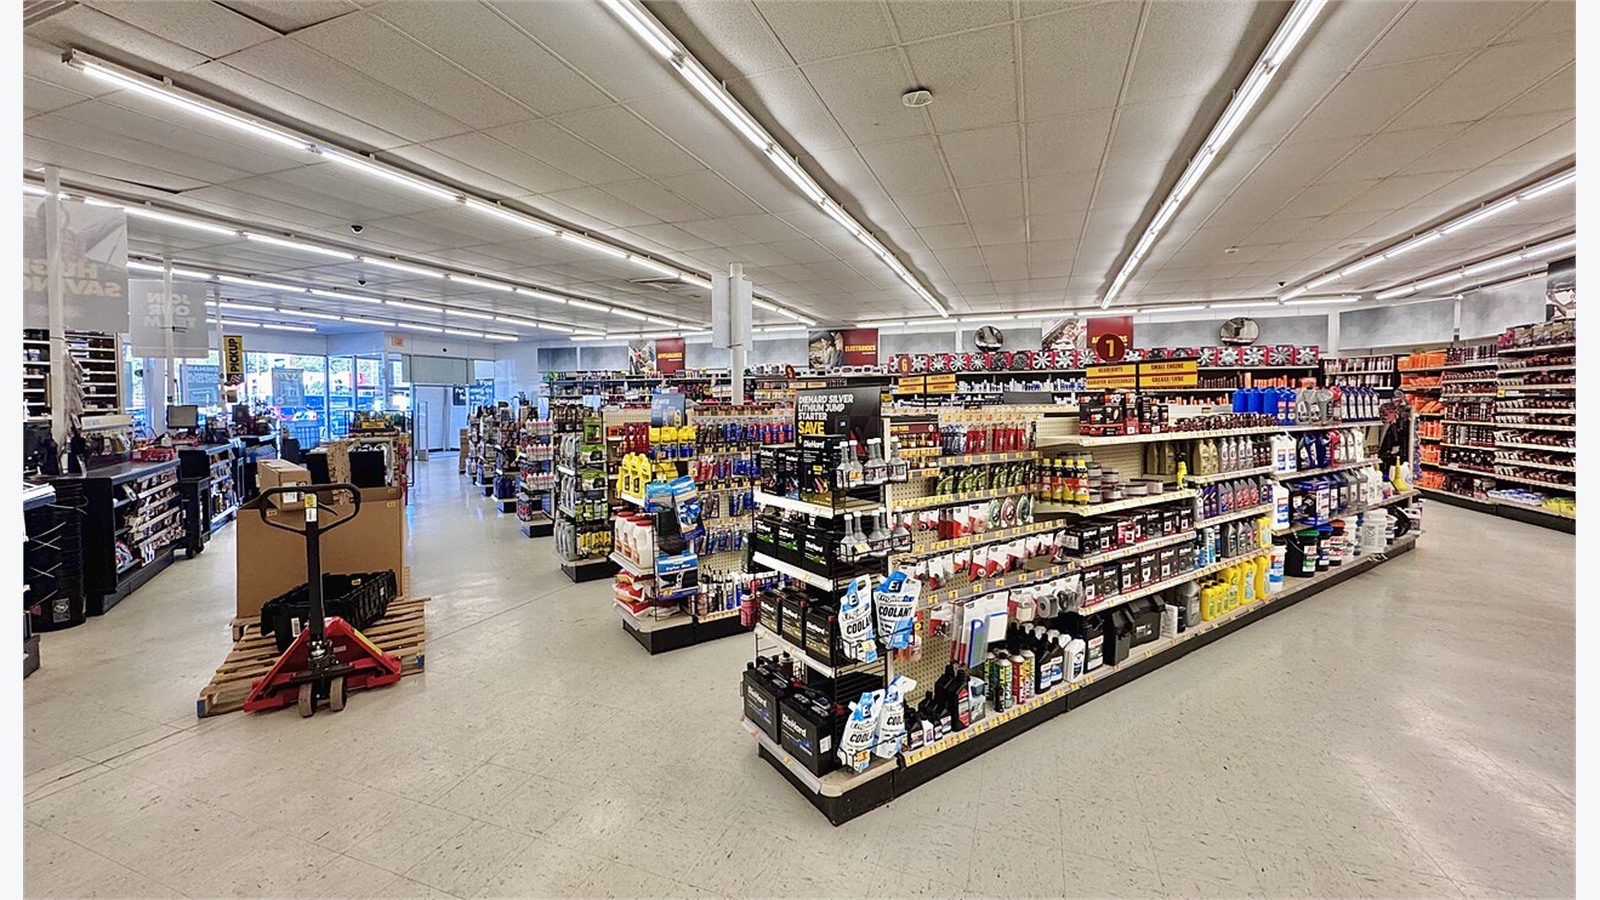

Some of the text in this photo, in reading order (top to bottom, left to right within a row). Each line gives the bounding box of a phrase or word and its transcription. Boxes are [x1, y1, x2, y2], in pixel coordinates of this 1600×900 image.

[228, 338, 240, 372] PICKUP
[1106, 340, 1115, 357] 1
[902, 358, 908, 372] 6
[798, 394, 854, 404] DIEHARD SILVER
[798, 404, 845, 412] LITHIUM JUMP
[798, 412, 827, 421] STARTER
[798, 421, 825, 435] SAVE
[803, 440, 825, 448] DieHard
[878, 605, 912, 618] COOLANT
[748, 685, 767, 708] DieHard
[782, 713, 807, 739] DieHard
